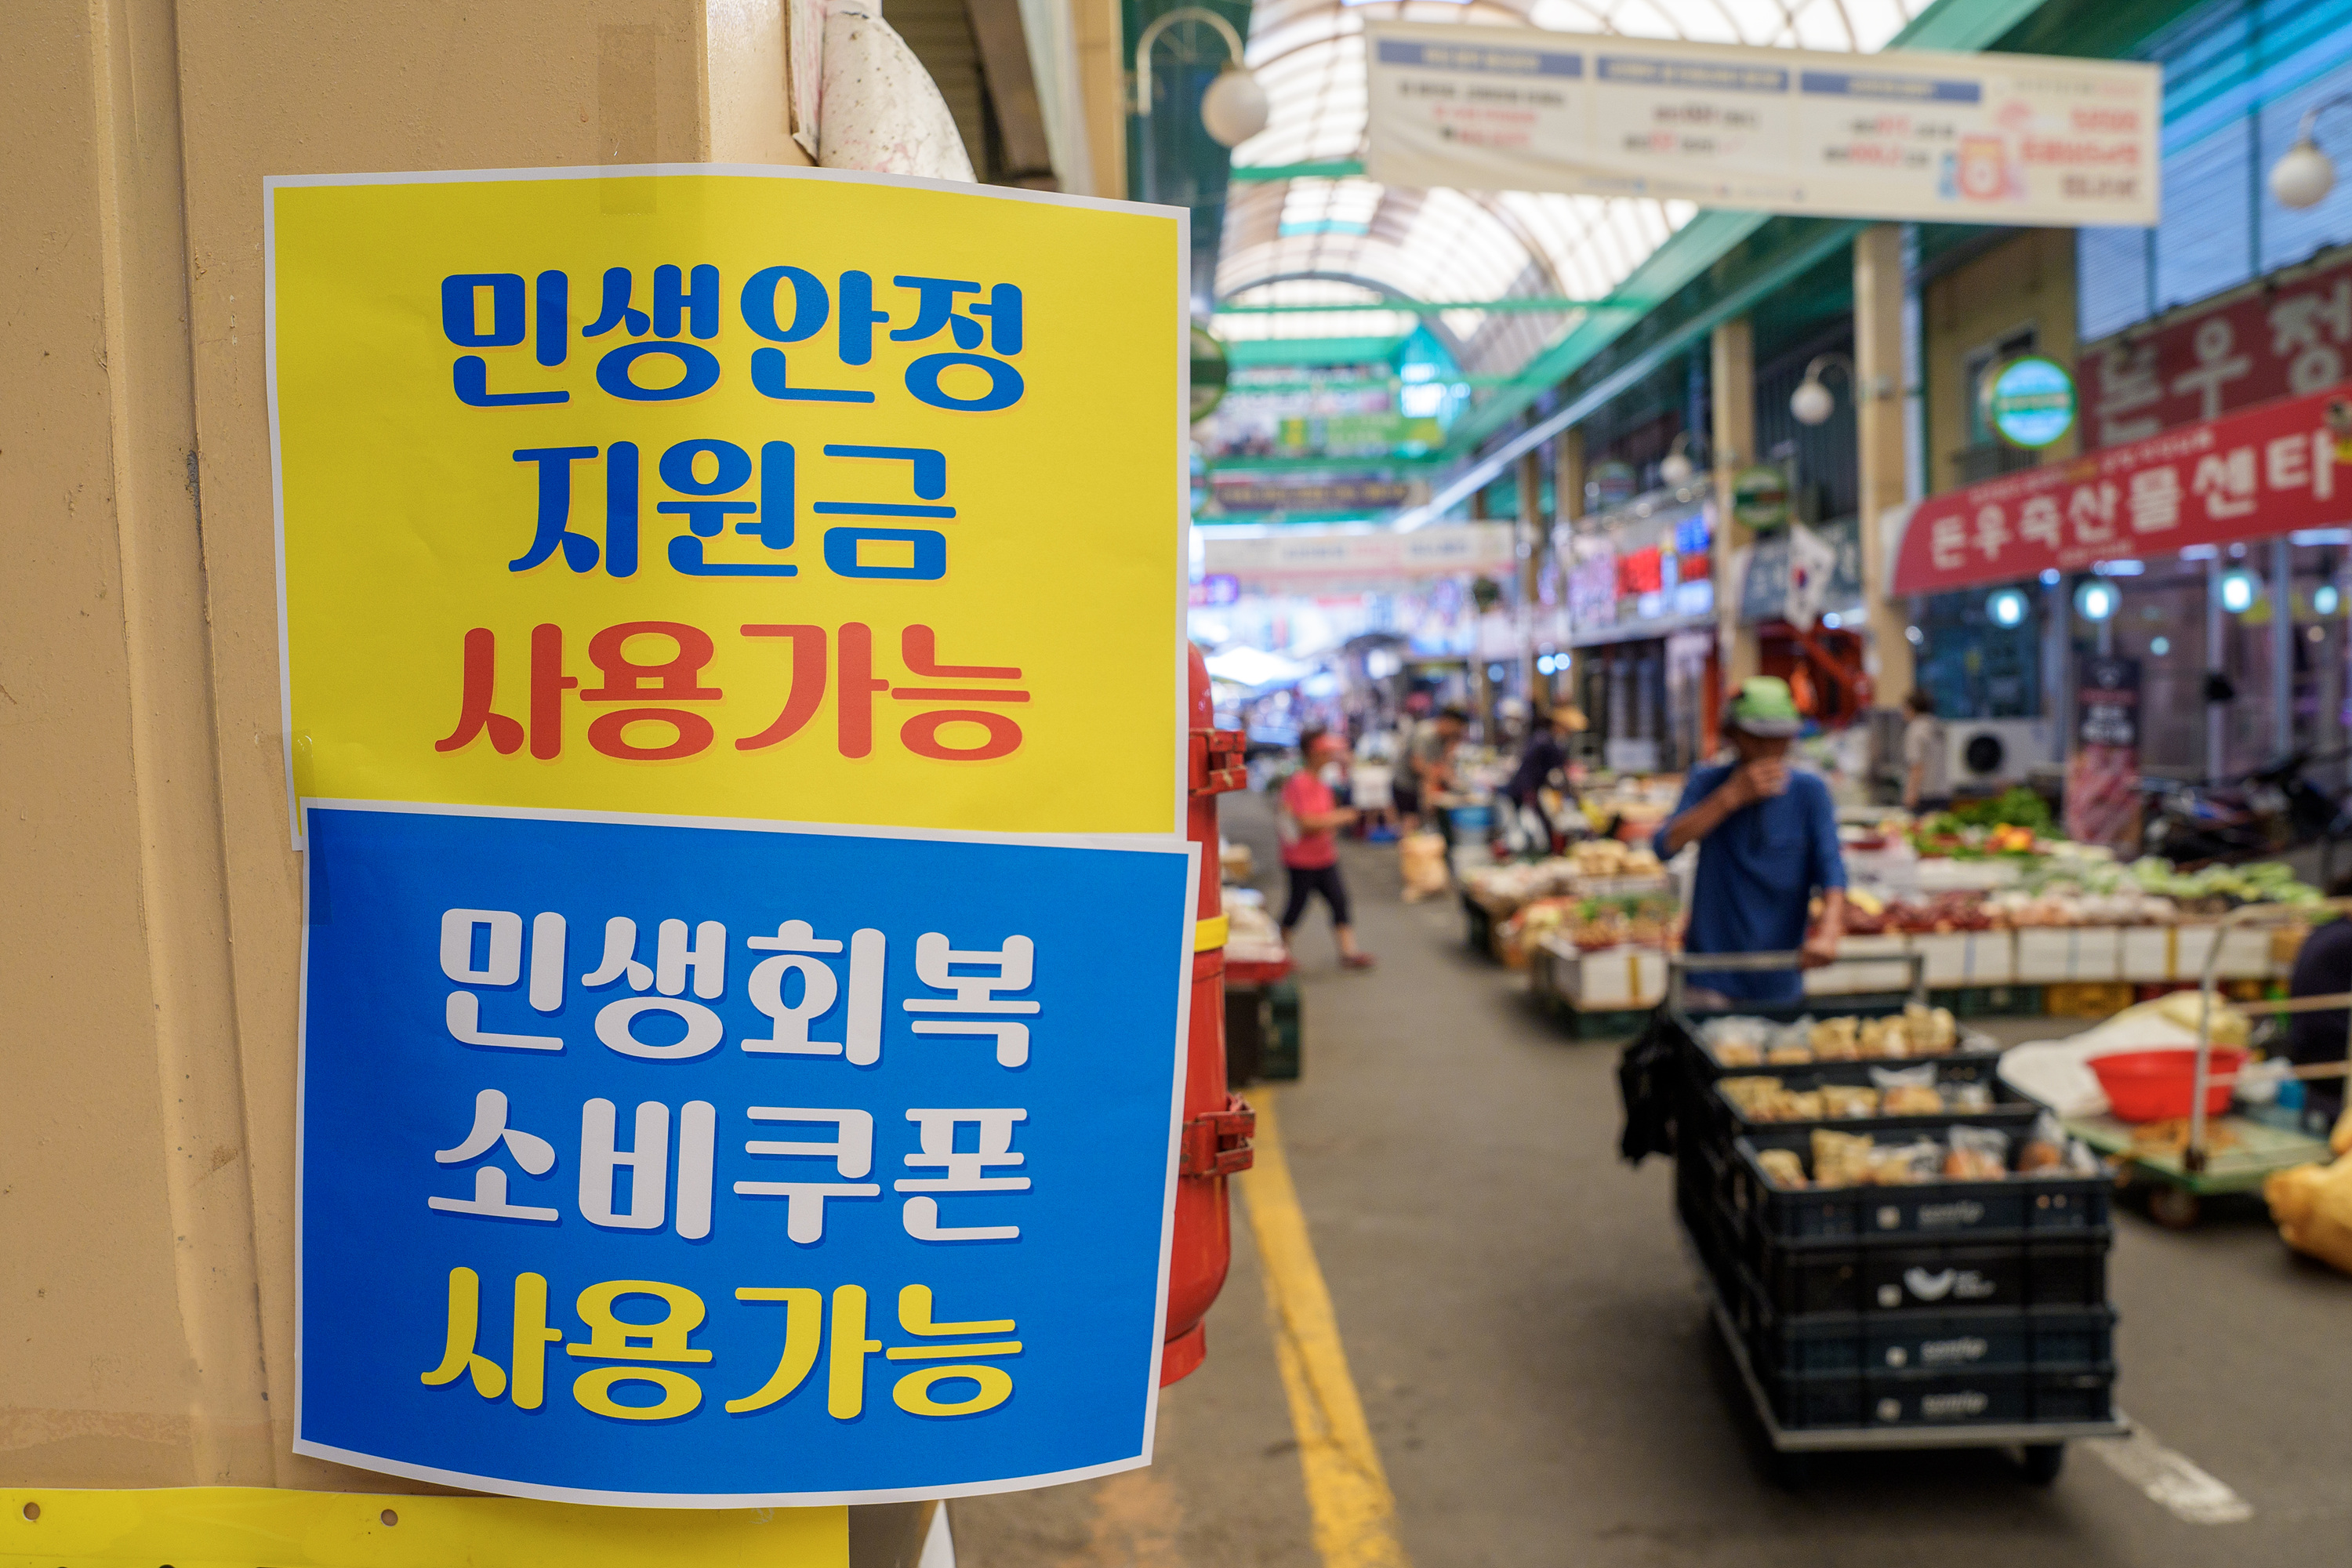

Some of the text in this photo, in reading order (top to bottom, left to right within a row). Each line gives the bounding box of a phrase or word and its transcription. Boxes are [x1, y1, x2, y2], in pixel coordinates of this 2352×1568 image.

[441, 263, 1025, 412] 민생안정
[508, 438, 956, 581] 지원금
[434, 621, 1031, 763] 사용가능
[439, 907, 1041, 1068] 민생회복
[427, 1089, 1032, 1244] 소비쿠폰
[421, 1266, 1023, 1421] 사용가능
